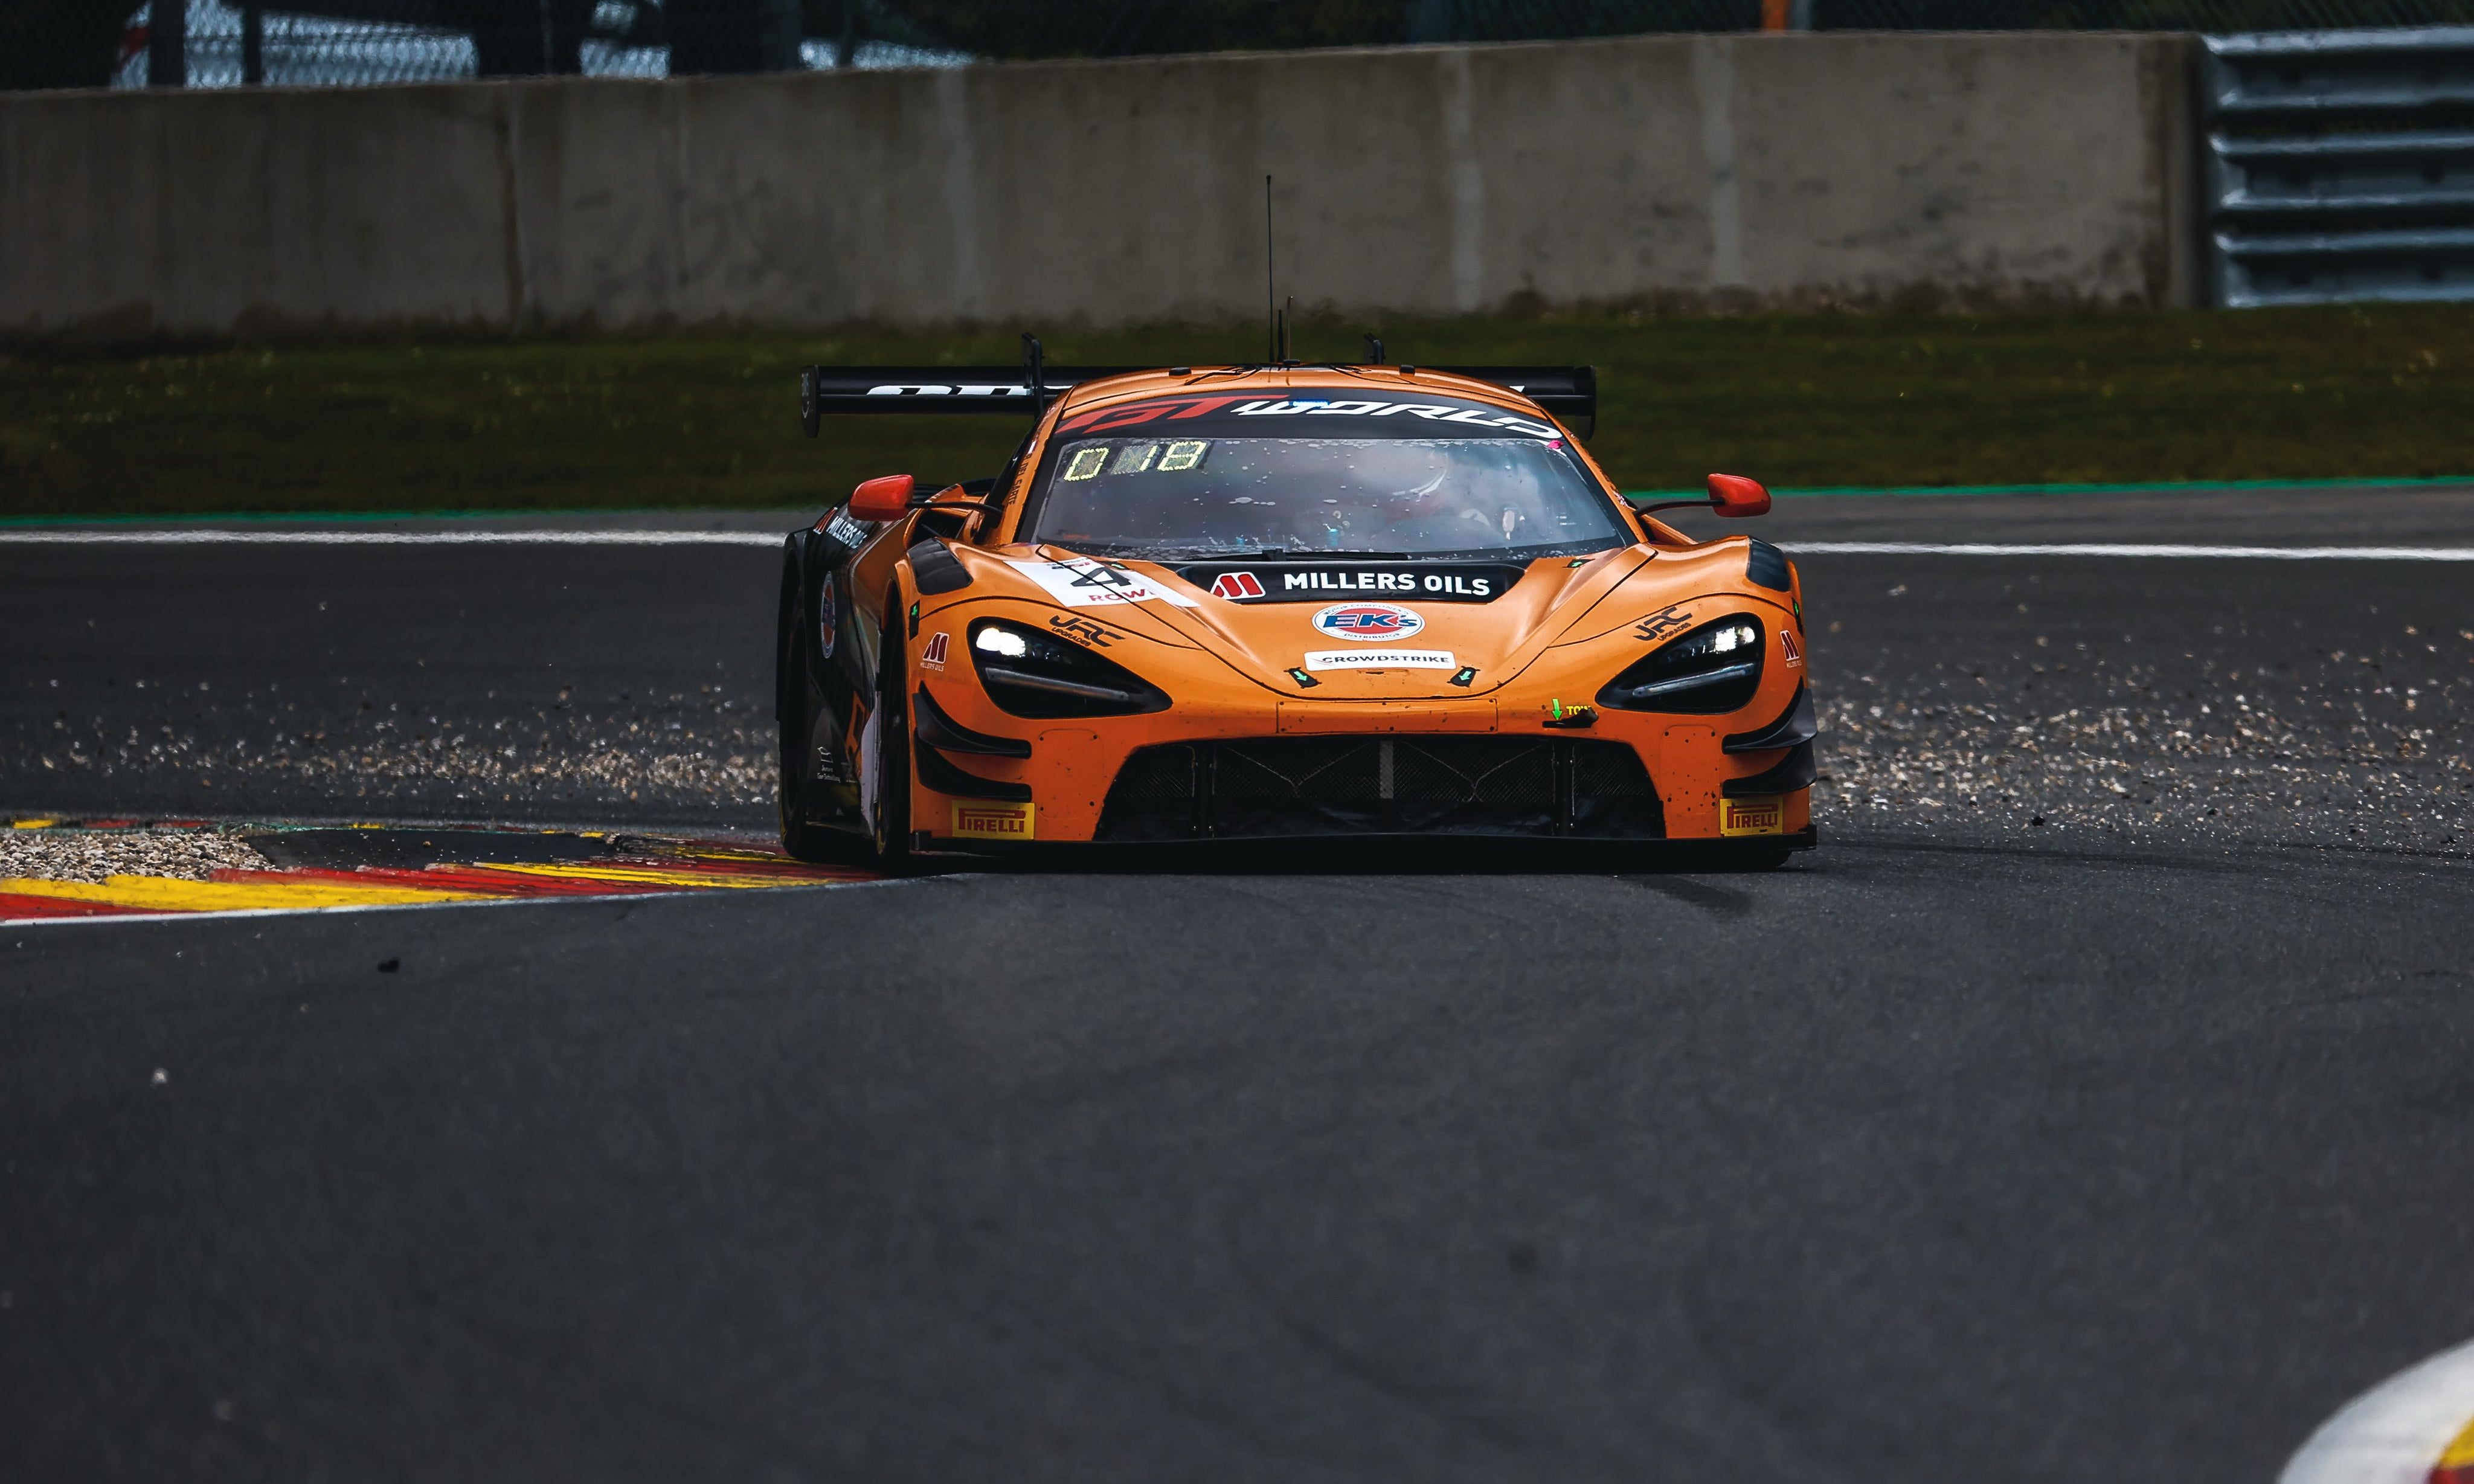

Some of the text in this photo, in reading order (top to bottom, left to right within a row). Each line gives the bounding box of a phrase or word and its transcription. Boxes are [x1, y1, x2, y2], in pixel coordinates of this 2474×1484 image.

[1053, 394, 1290, 434] GT
[1230, 400, 1563, 439] WORLD
[826, 515, 858, 545] MILLERS
[1070, 567, 1133, 587] 4
[1284, 572, 1415, 590] MILLERS
[1424, 575, 1491, 596] OILS
[1049, 615, 1125, 647] JRC
[1633, 606, 1692, 641] JRC
[1322, 655, 1450, 663] CROWDSTRIKE
[959, 808, 1026, 832] PIRELLI
[1727, 804, 1778, 829] PIRELLI
